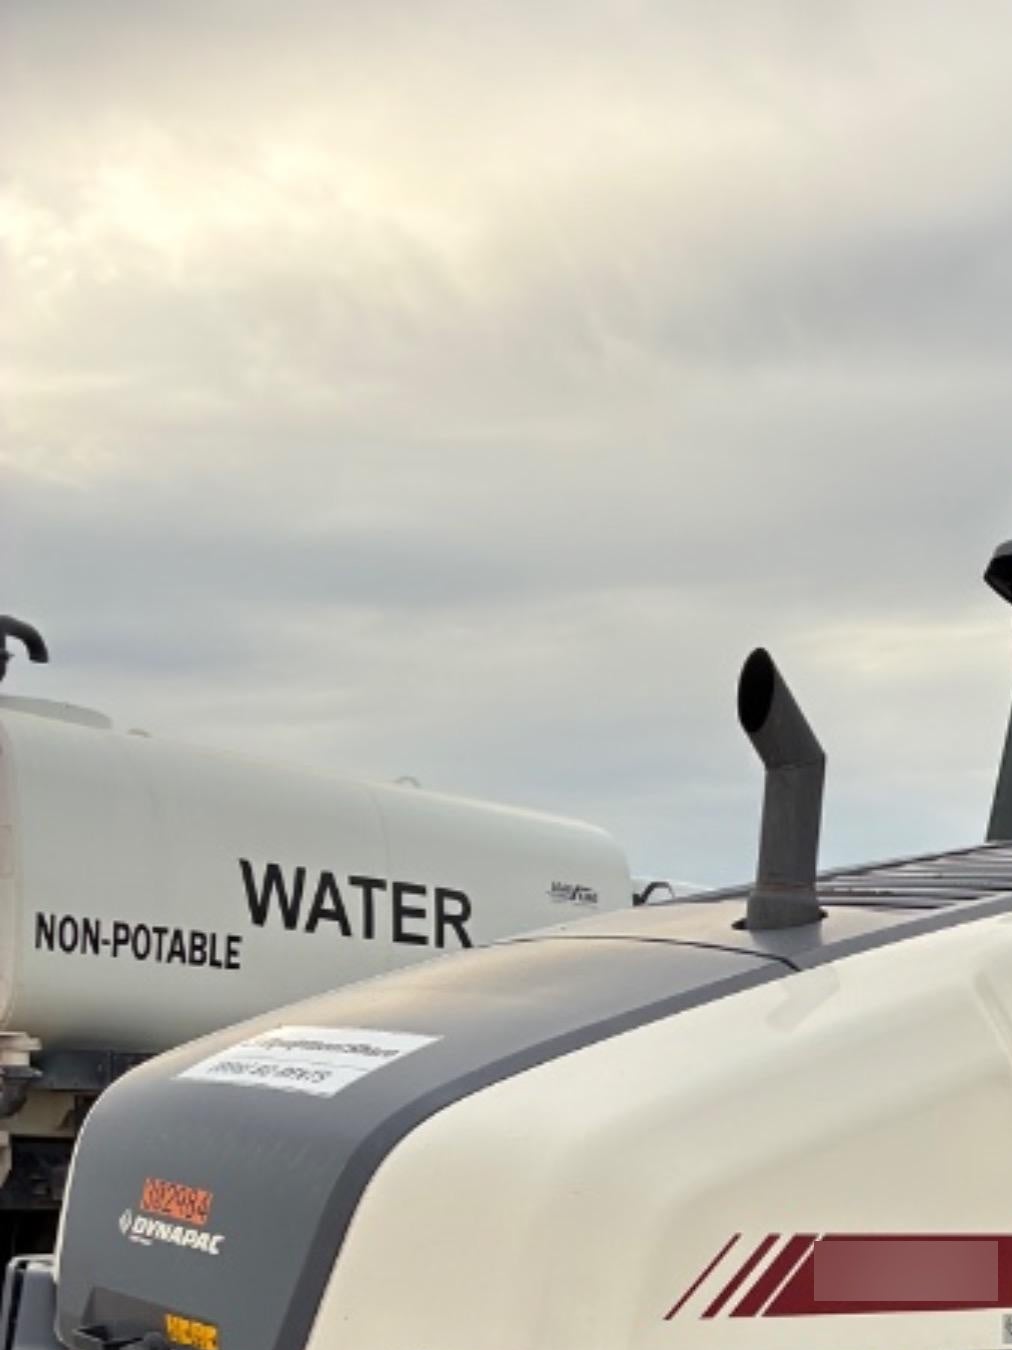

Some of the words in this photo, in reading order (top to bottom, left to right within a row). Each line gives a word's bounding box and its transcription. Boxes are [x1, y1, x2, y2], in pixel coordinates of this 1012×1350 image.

[238, 857, 473, 949] WATER
[34, 911, 243, 970] NON-POTABLE
[131, 1215, 226, 1255] DYNAPAC
